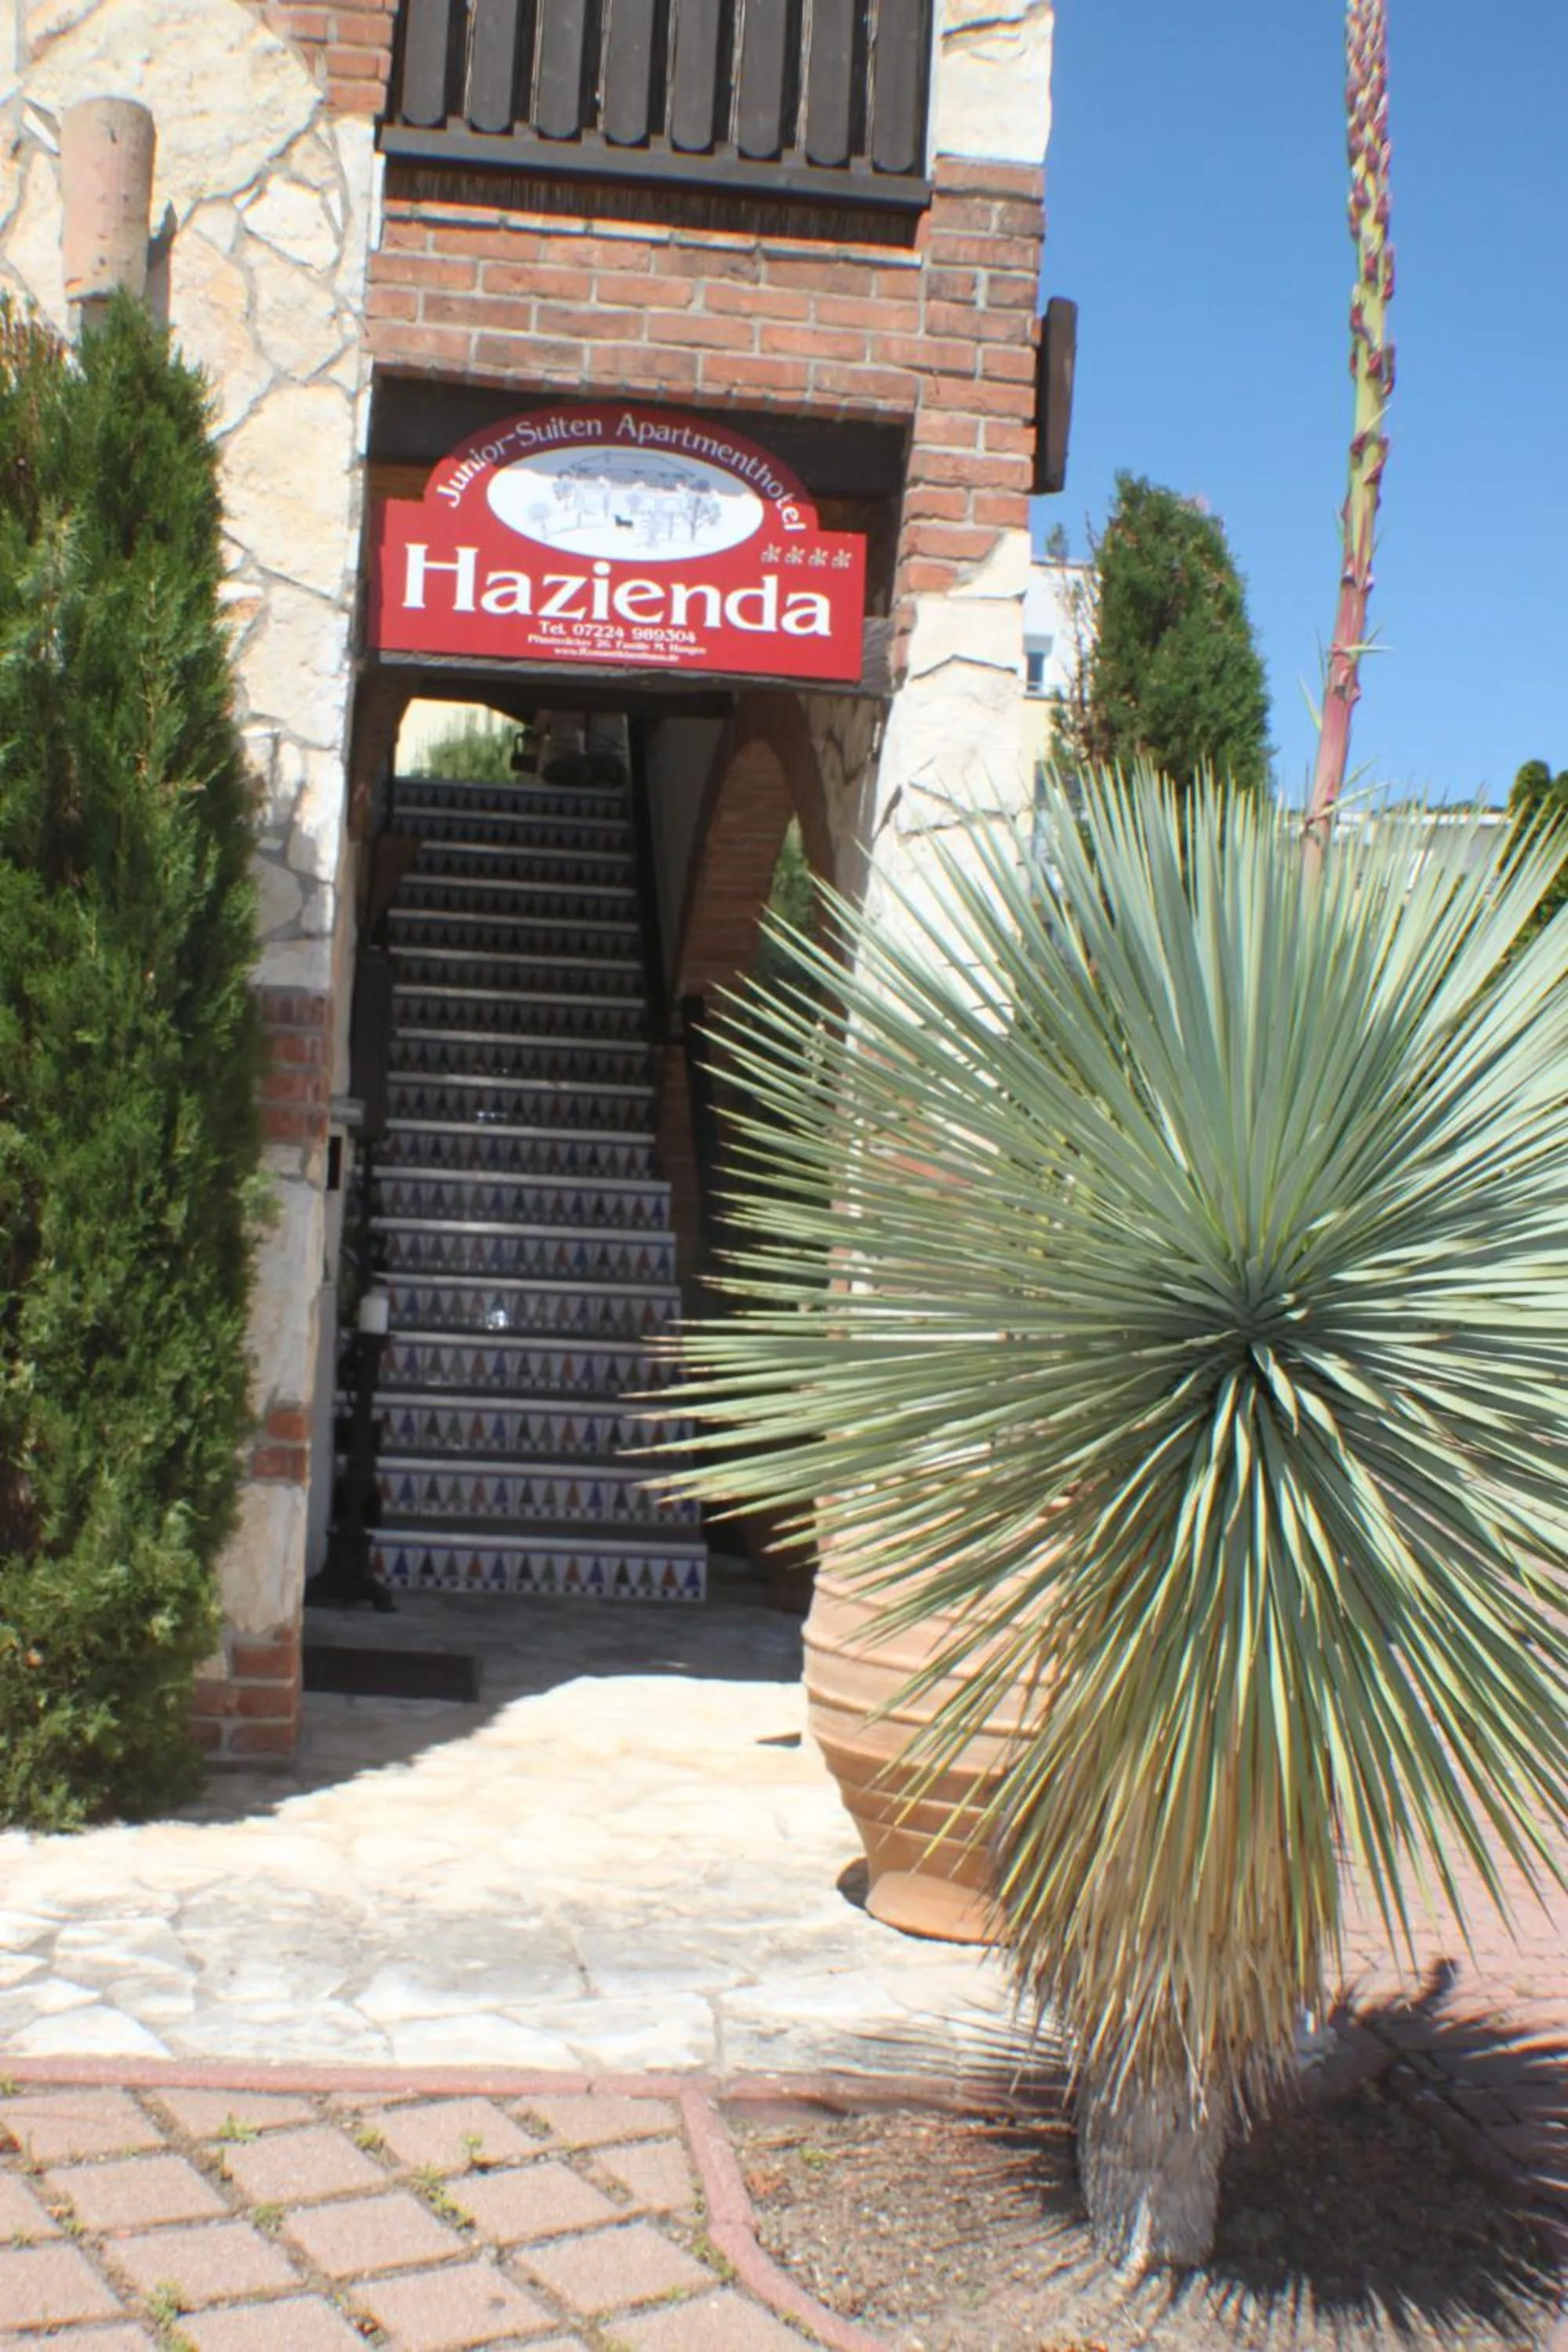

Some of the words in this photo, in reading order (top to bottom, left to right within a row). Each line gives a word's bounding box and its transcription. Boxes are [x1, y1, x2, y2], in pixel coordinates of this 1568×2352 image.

[437, 416, 602, 508] Junior-Suiten
[615, 413, 806, 531] Apartmenthotel
[402, 543, 832, 636] Hazienda
[539, 620, 566, 636] Tel.
[572, 623, 624, 639] 07224
[632, 626, 696, 644] 989304
